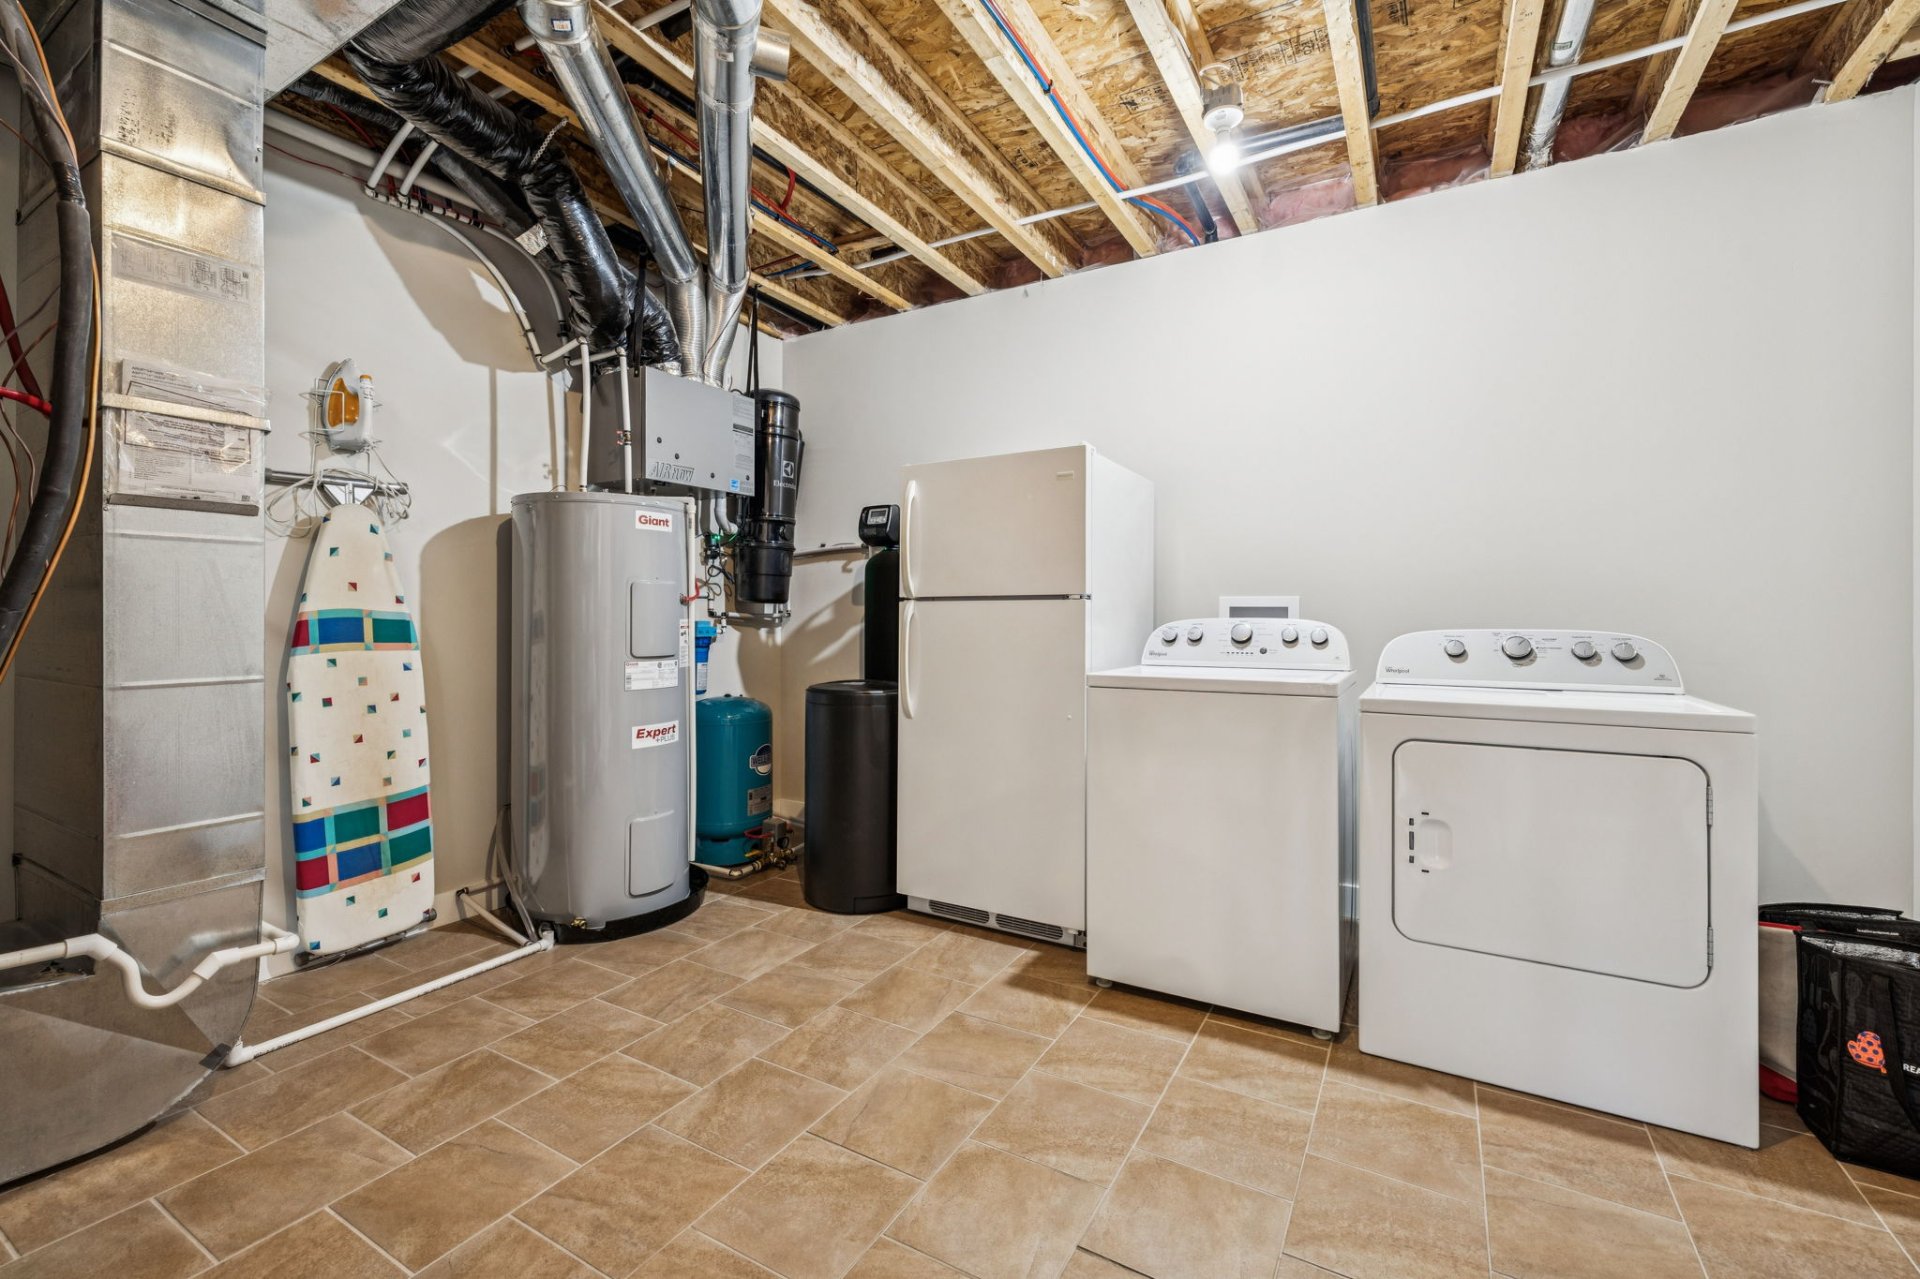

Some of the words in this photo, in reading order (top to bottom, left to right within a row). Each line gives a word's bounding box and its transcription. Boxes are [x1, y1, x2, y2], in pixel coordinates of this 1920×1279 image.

[638, 515, 669, 527] Giant
[1385, 666, 1410, 674] Whirlpool
[636, 724, 676, 739] Expert
